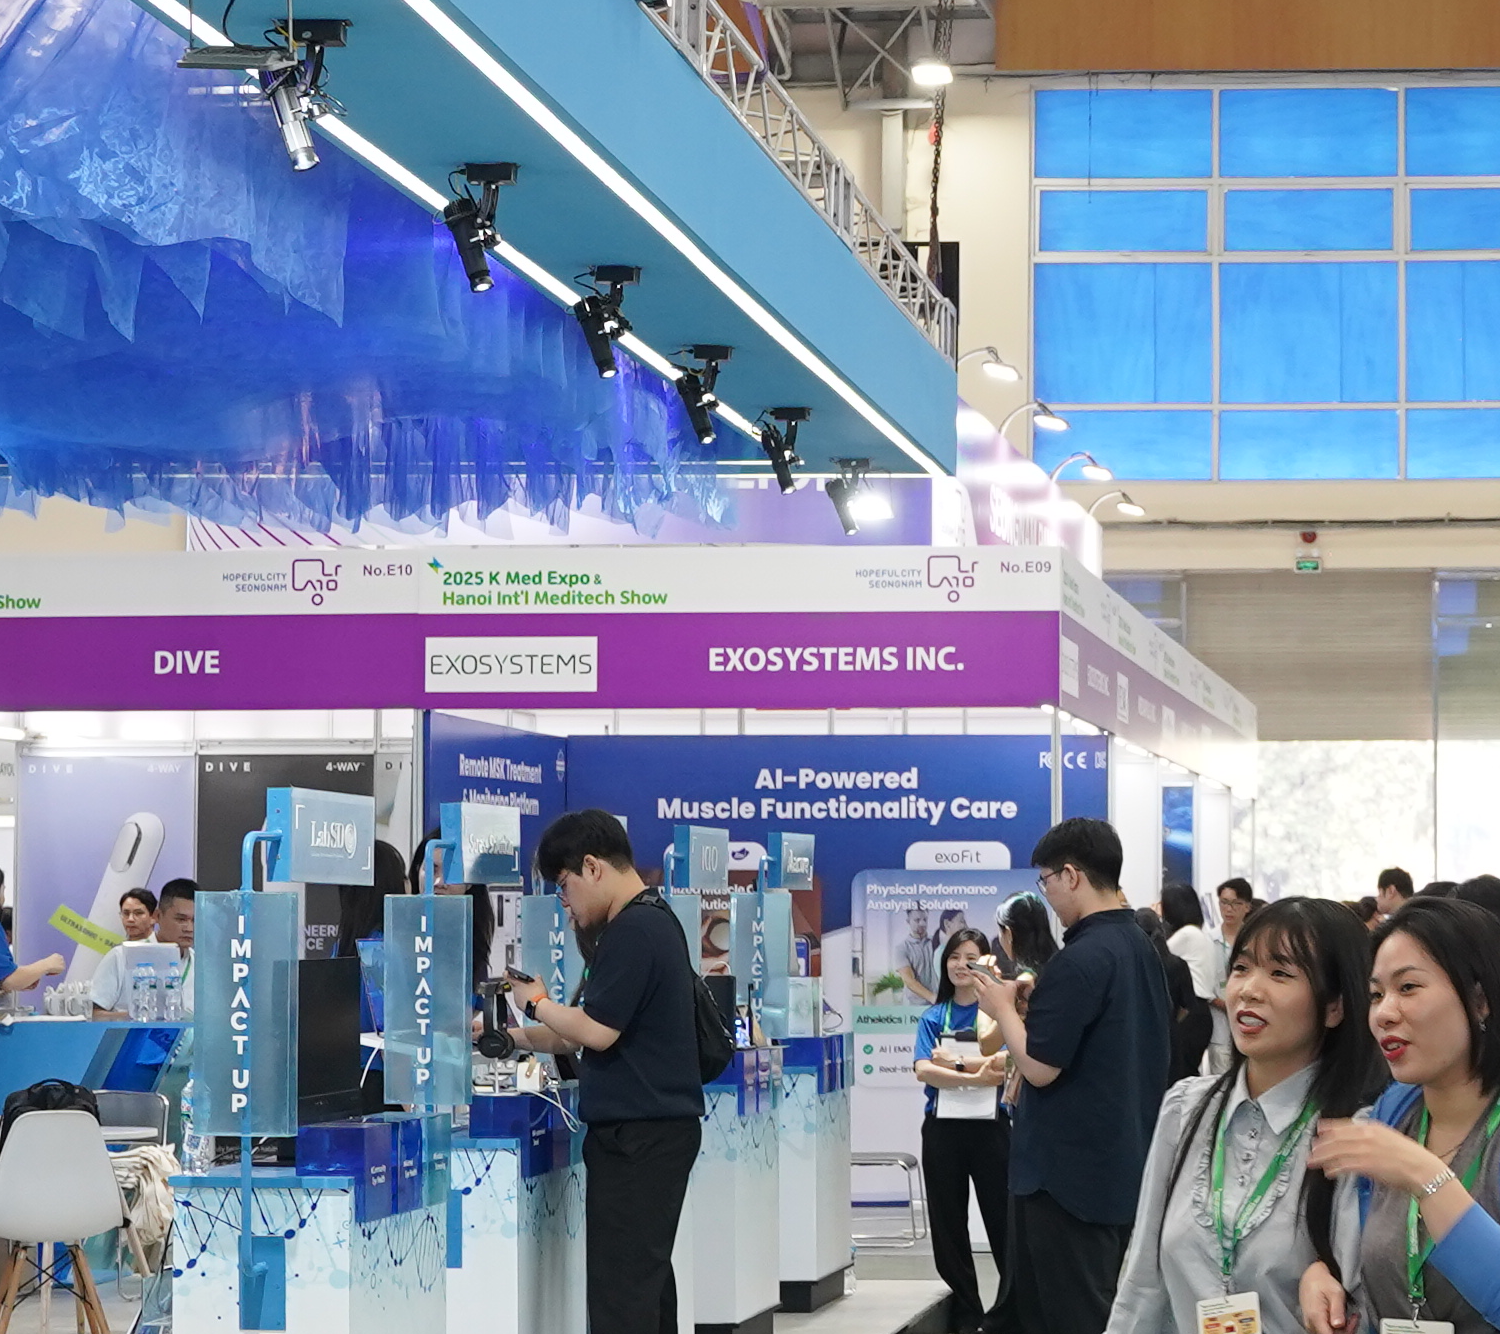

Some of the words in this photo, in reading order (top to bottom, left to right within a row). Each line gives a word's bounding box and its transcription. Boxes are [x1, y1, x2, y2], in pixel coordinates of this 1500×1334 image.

[363, 564, 413, 576] No.E10
[1000, 560, 1052, 574] No.E09
[443, 571, 484, 586] 2025
[489, 570, 500, 586] K
[504, 570, 543, 586] Med
[548, 570, 589, 589] Expo
[442, 589, 491, 605] Hanoi
[496, 589, 528, 605] Int'l
[534, 589, 614, 605] Meditech
[619, 589, 668, 605] Show
[154, 650, 220, 675] DIVE
[430, 652, 592, 676] EXOSYSTEMS
[708, 647, 898, 672] EXOSYSTEMS
[906, 646, 965, 672] INC.
[28, 763, 73, 774] DIVE
[205, 762, 251, 772] DIVE
[325, 762, 360, 772] 4-WAY
[459, 753, 488, 777] Remote
[489, 756, 506, 780] MSK
[506, 758, 542, 784] Treatment
[755, 767, 918, 791] AI-Powered
[657, 797, 754, 820] Muscle
[760, 795, 944, 827] Functionality
[949, 796, 1017, 819] Care
[935, 849, 981, 864] exoFit
[866, 883, 918, 898] Physical
[919, 883, 998, 896] Performance
[866, 898, 918, 912] Analysis
[919, 898, 969, 911] Solution
[230, 915, 252, 1057] IMPACT
[414, 915, 434, 1036] IMPACT
[415, 1047, 432, 1086] UP
[231, 1069, 249, 1114] UP
